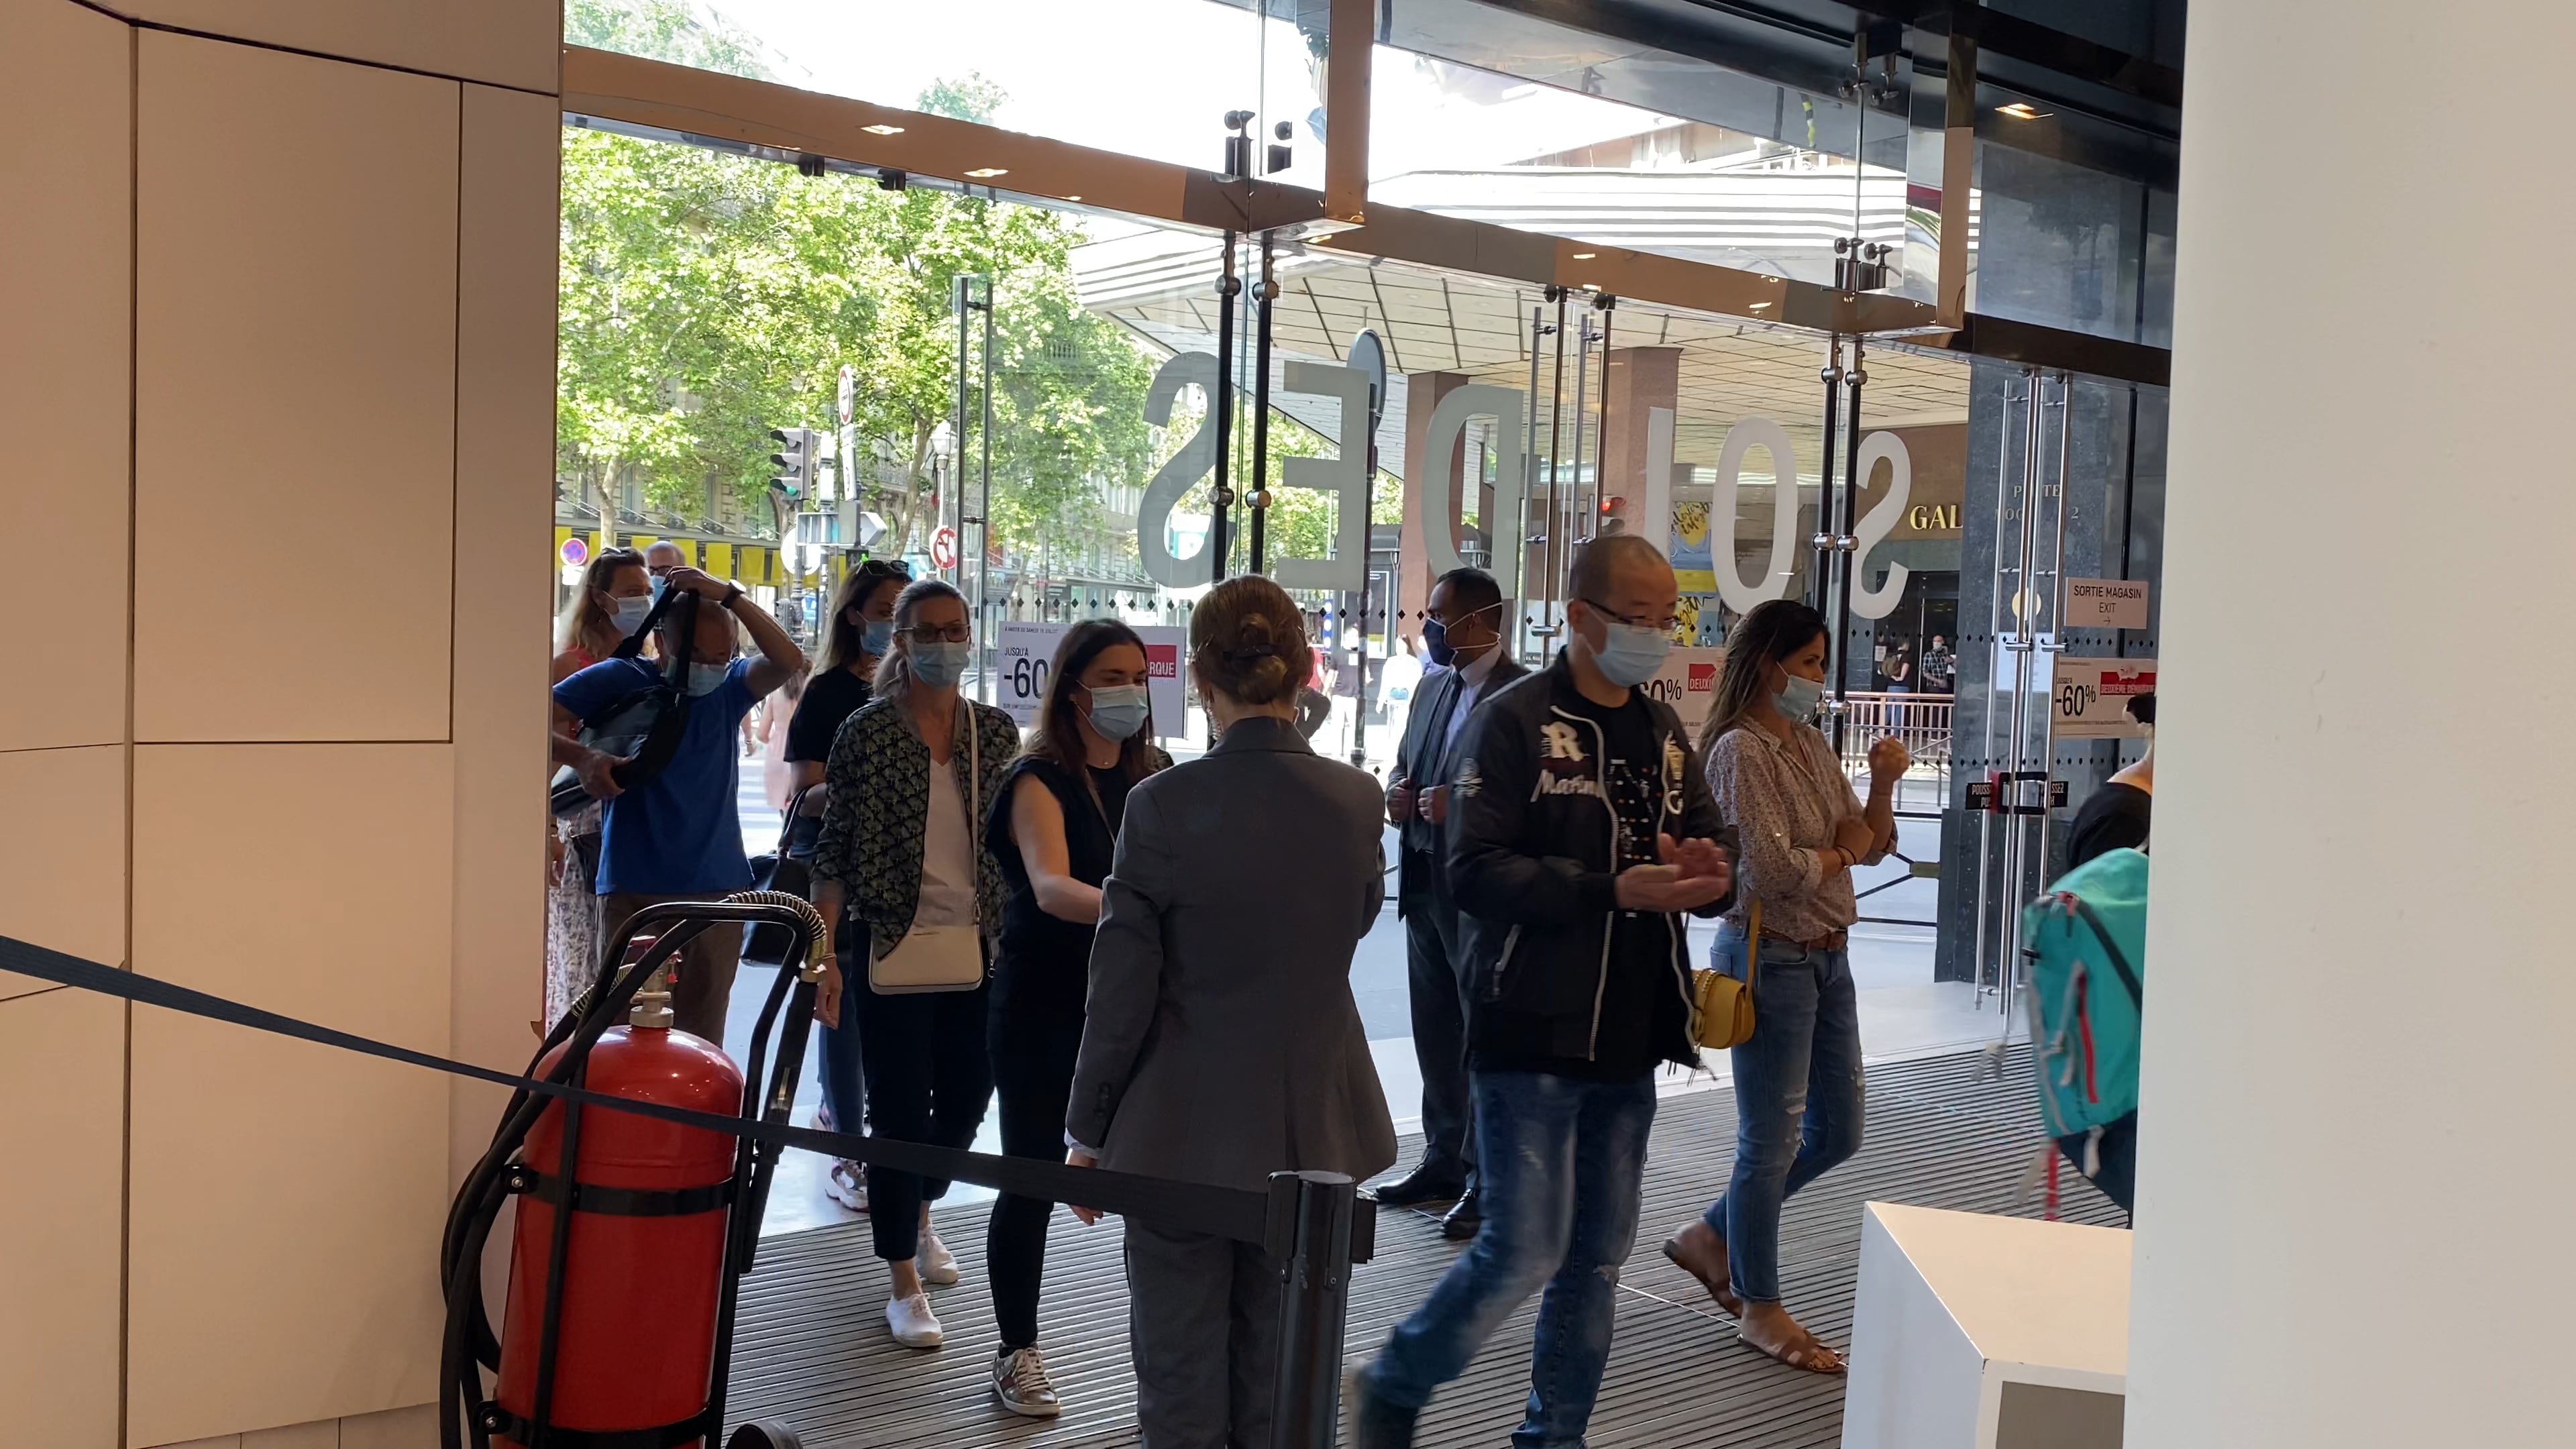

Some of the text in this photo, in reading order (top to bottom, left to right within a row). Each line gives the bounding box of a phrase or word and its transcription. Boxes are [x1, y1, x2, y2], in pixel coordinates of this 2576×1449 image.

[2013, 484, 2060, 498] PTE
[2074, 585, 2141, 599] SORTIE MAGASIN
[2099, 602, 2116, 613] EXIT
[1148, 661, 1175, 676] RQUE
[2055, 685, 2096, 716] -60%
